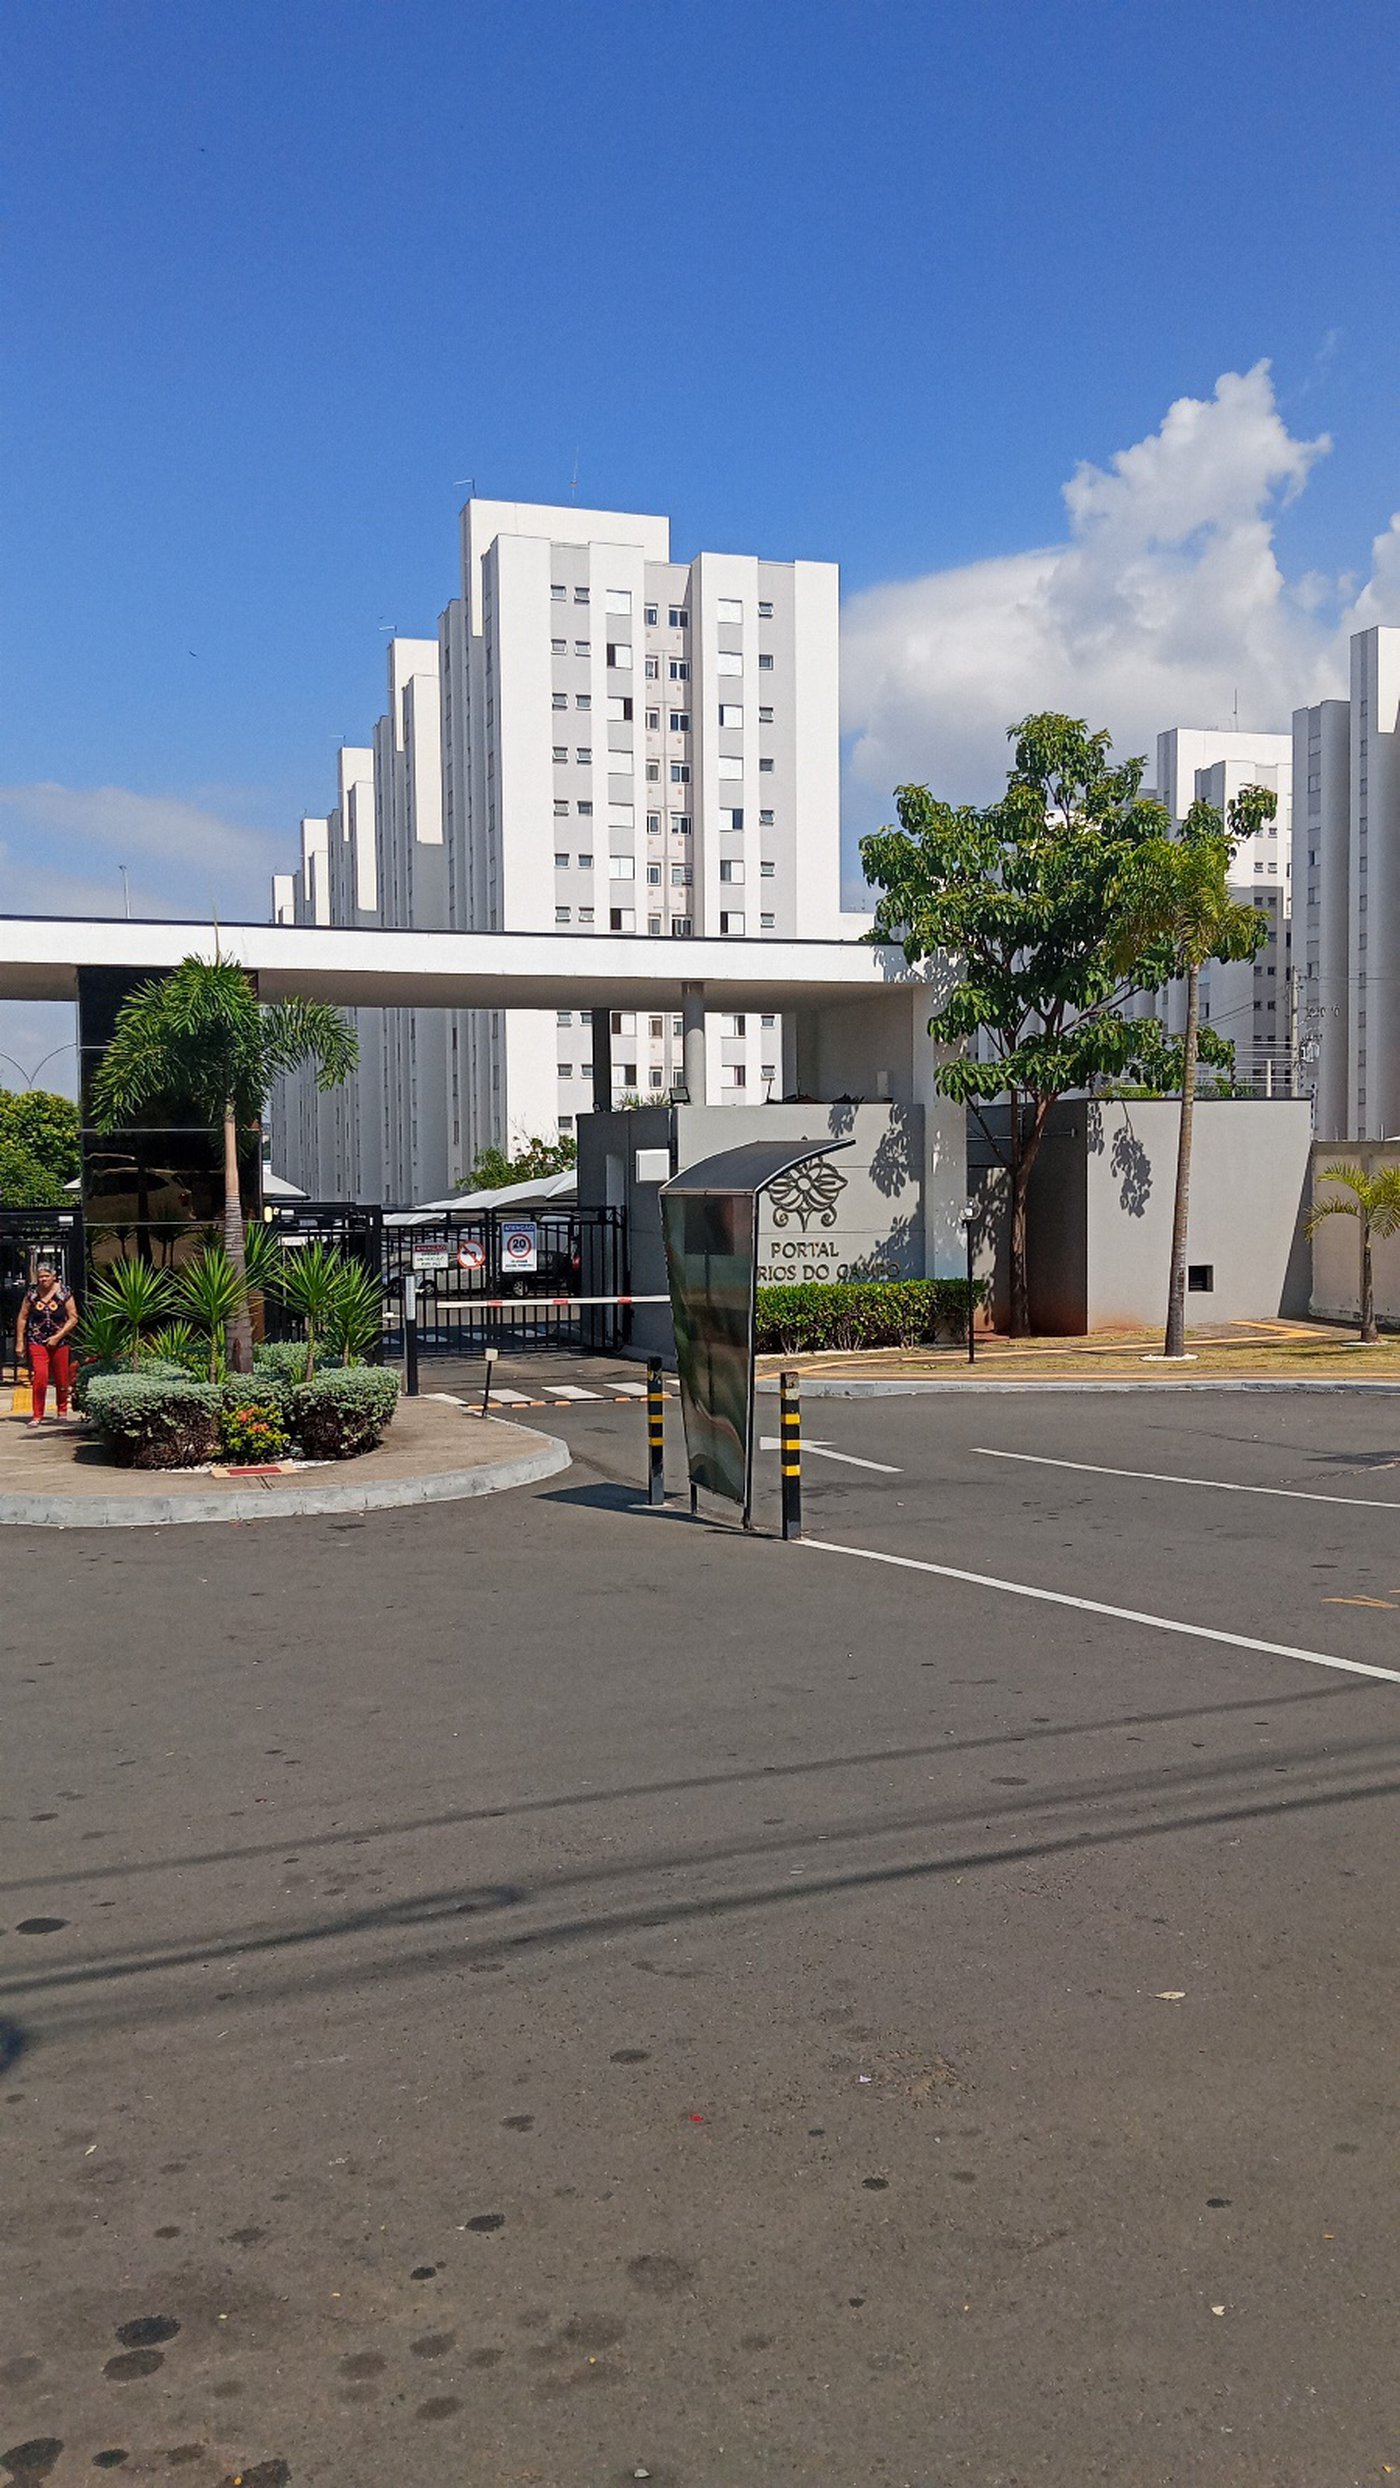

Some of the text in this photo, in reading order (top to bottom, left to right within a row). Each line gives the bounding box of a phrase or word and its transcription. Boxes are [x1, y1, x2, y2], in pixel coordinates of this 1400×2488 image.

[512, 1238, 527, 1249] 20
[771, 1242, 840, 1259] PORTAL
[802, 1264, 830, 1281] DO
